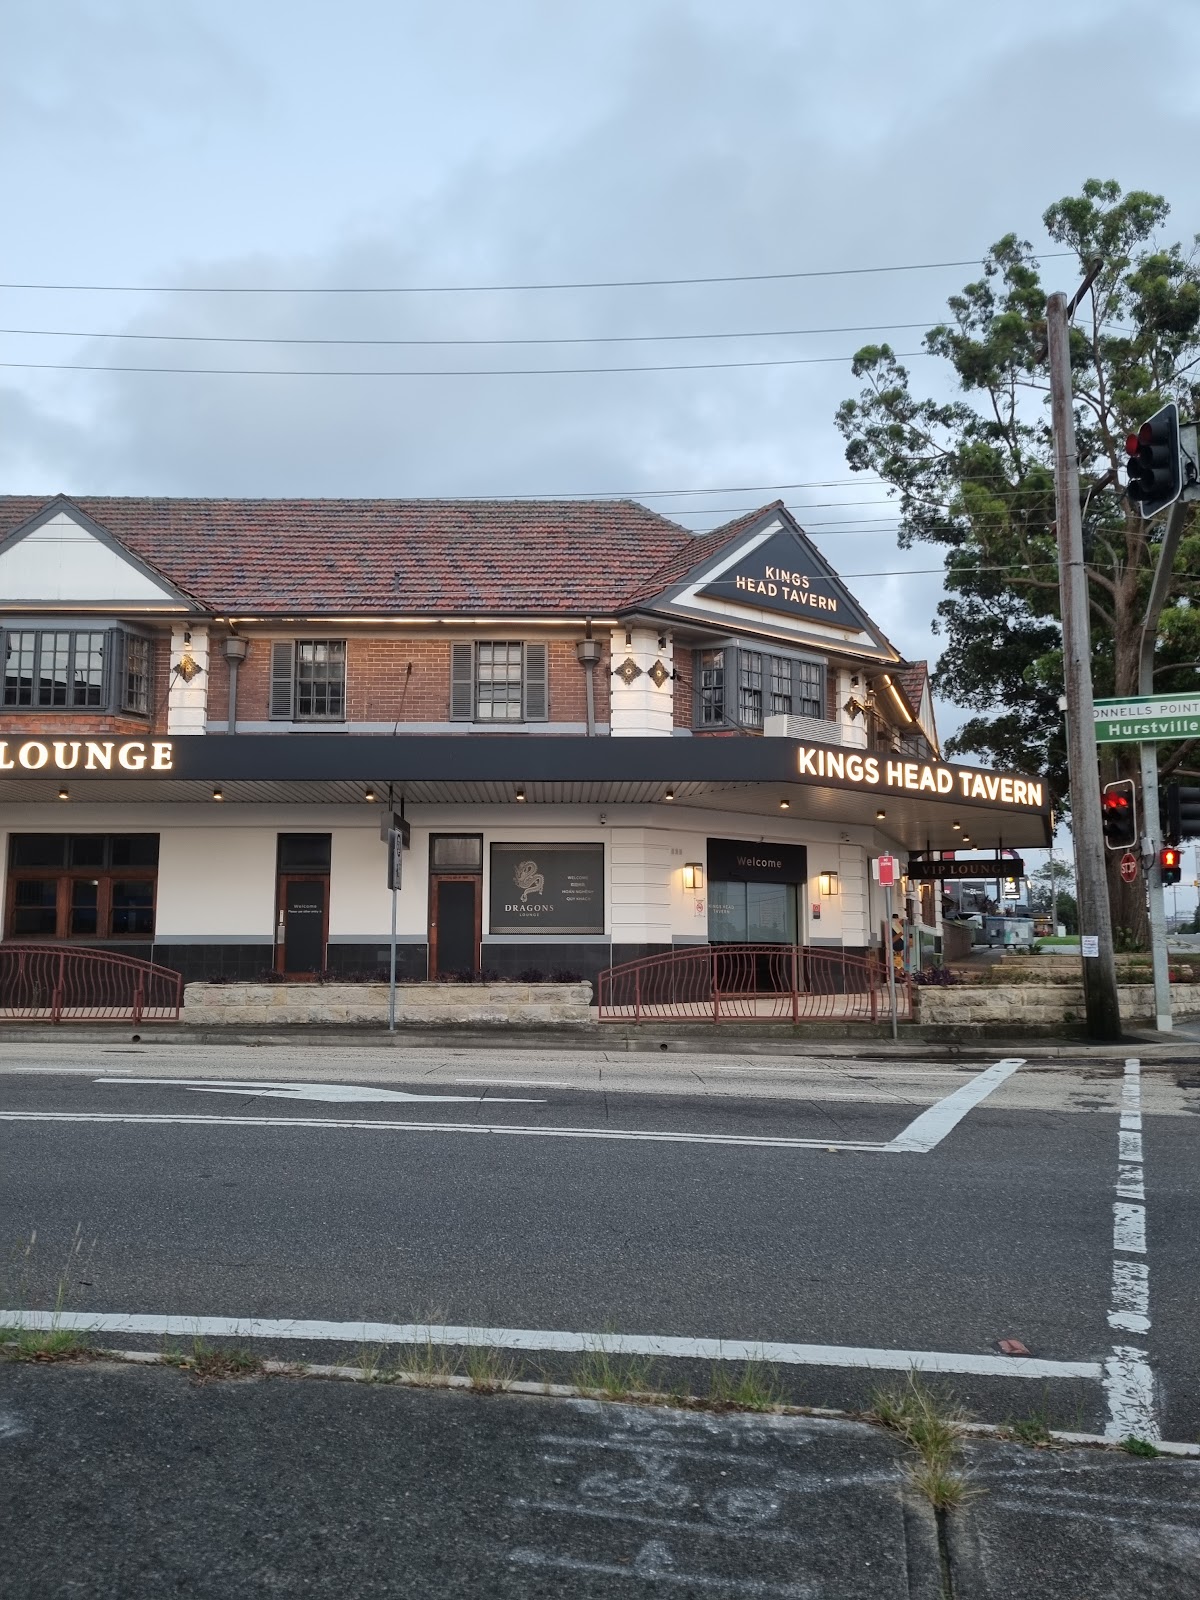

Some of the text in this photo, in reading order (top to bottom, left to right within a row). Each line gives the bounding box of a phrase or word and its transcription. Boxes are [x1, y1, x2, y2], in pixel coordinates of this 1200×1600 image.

[765, 565, 810, 589] KINGS
[736, 575, 837, 612] HEAD TAVERN
[1093, 703, 1199, 719] ONNELLS POINT
[1108, 719, 1199, 736] Hurstville
[0, 741, 173, 770] LOUNGE
[799, 746, 1043, 807] KINGS HEAD TAVERN
[736, 855, 782, 868] Welcome
[921, 862, 1008, 876] VIP LOUNGE
[1121, 862, 1136, 874] STOP
[505, 904, 554, 912] DRAGONS
